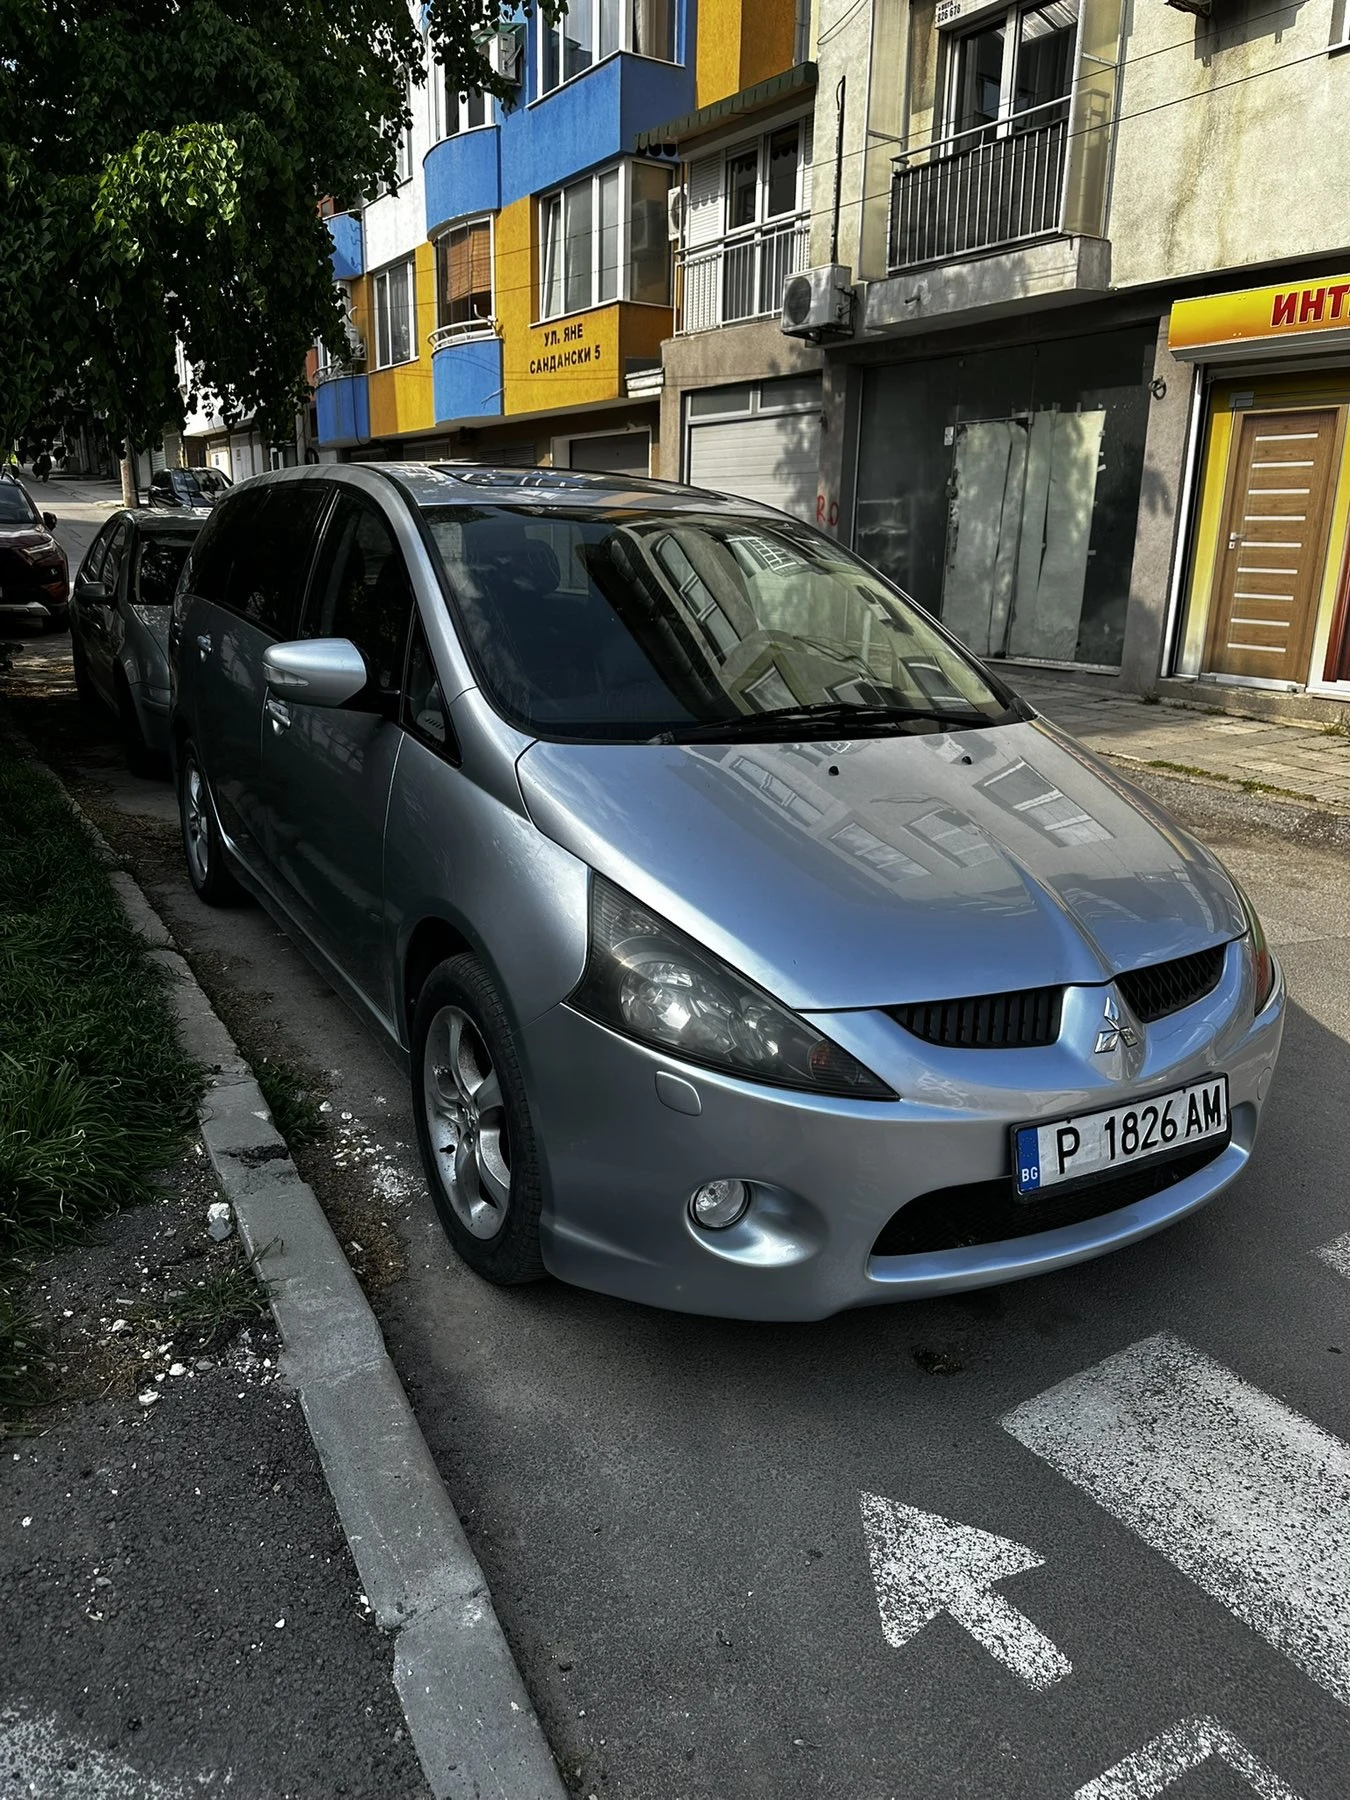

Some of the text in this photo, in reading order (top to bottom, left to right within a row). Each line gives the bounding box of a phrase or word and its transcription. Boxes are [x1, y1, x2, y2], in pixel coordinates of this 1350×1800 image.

[1270, 283, 1350, 327] ИНТ
[544, 323, 583, 347] УЛ. ЯНЕ
[530, 344, 601, 374] САНДАНСКИ 5
[1056, 1085, 1222, 1175] P 1826 AM
[1021, 1166, 1039, 1182] BG
